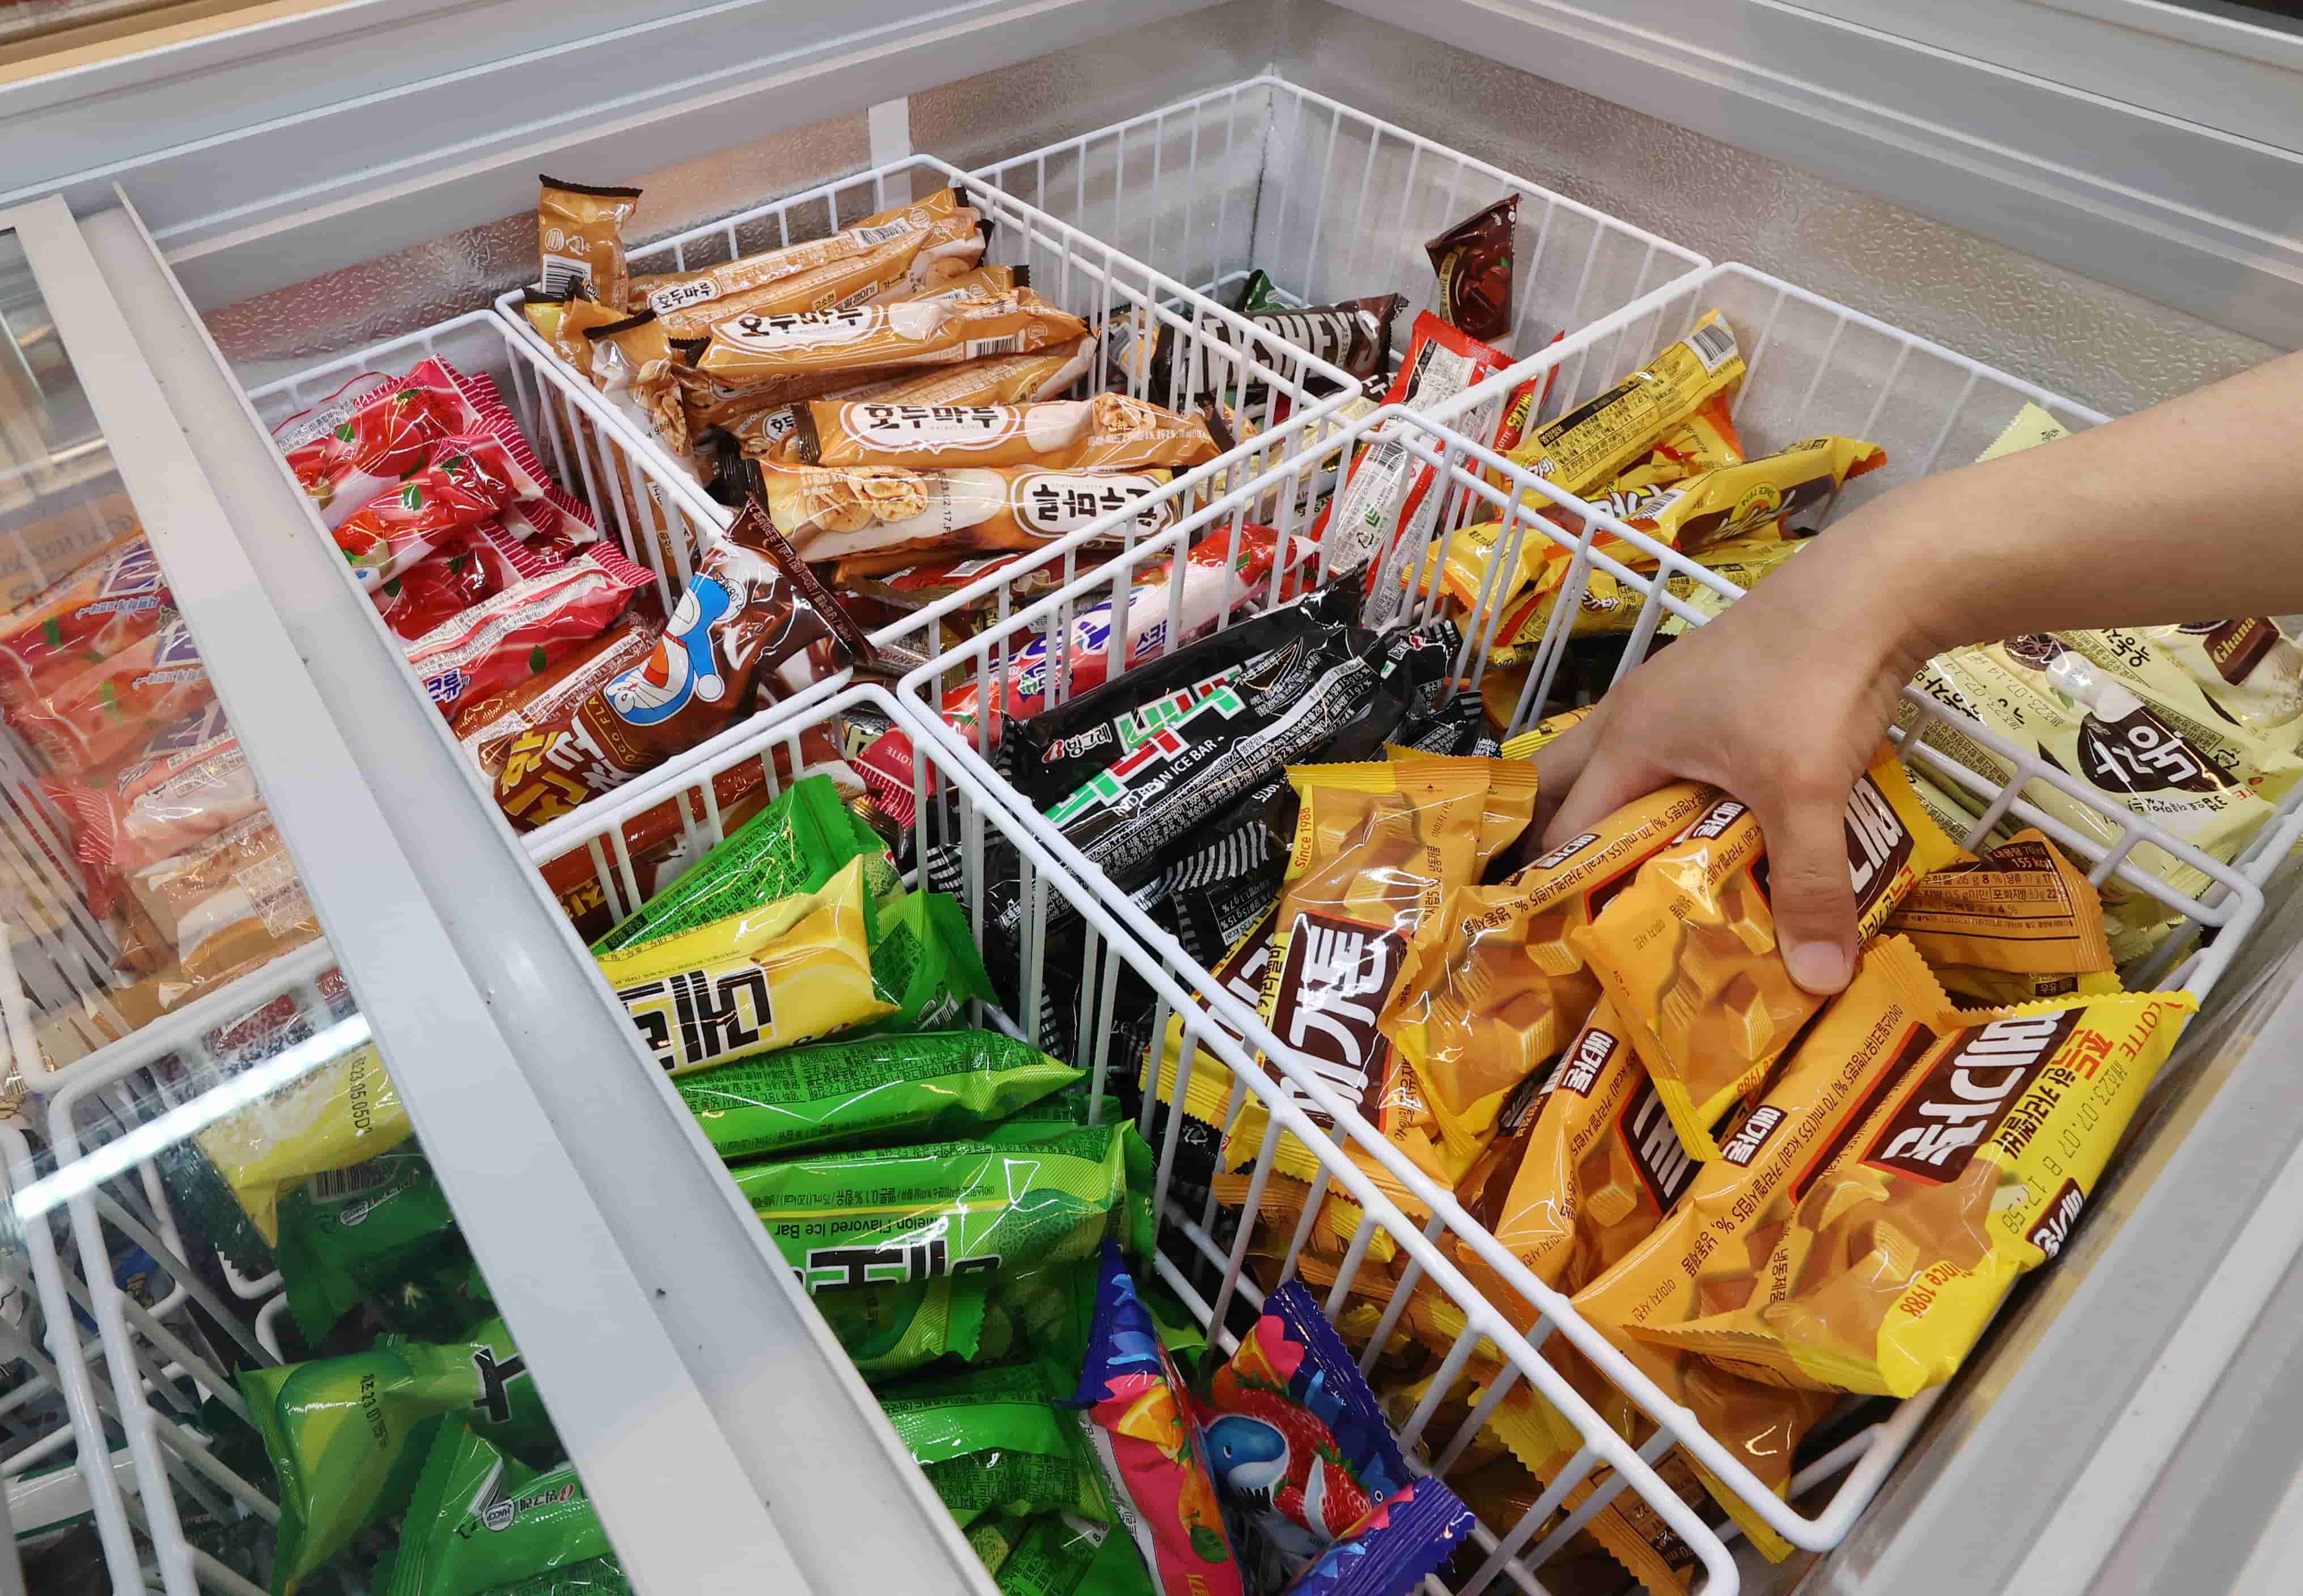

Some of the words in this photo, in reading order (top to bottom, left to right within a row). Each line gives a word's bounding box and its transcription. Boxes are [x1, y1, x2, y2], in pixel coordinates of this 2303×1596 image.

[656, 281, 712, 309] 호두마루
[865, 404, 999, 430] 호두마루
[2214, 616, 2256, 664] Ghana
[1062, 717, 1114, 763] 빙그레
[1169, 754, 1193, 776] ICE
[1189, 736, 1218, 761] BAR
[1296, 805, 1315, 833] 1988
[1637, 824, 1654, 841] 70
[1293, 834, 1313, 869] Since
[2012, 857, 2032, 868] 155
[1983, 875, 1988, 884] 8
[2117, 998, 2166, 1064] LOTTE
[1558, 1027, 1618, 1097] 메가톤
[2041, 1020, 2115, 1101] 쫀득한
[1819, 1092, 1839, 1111] 70
[1880, 1010, 2067, 1166] 메가톤
[1720, 1098, 1783, 1171] 메가톤
[1728, 1157, 1787, 1226] 카라멜시럽5
[774, 1223, 800, 1239] Bar
[805, 1223, 826, 1237] Ice
[829, 1218, 891, 1236] Flavored
[1674, 1229, 1723, 1278] 냉동제품
[1648, 1277, 1678, 1306] 이미지
[1769, 1247, 1789, 1304] 냉동제품
[1628, 1297, 1655, 1325] 사진
[1895, 1279, 1942, 1324] 1988
